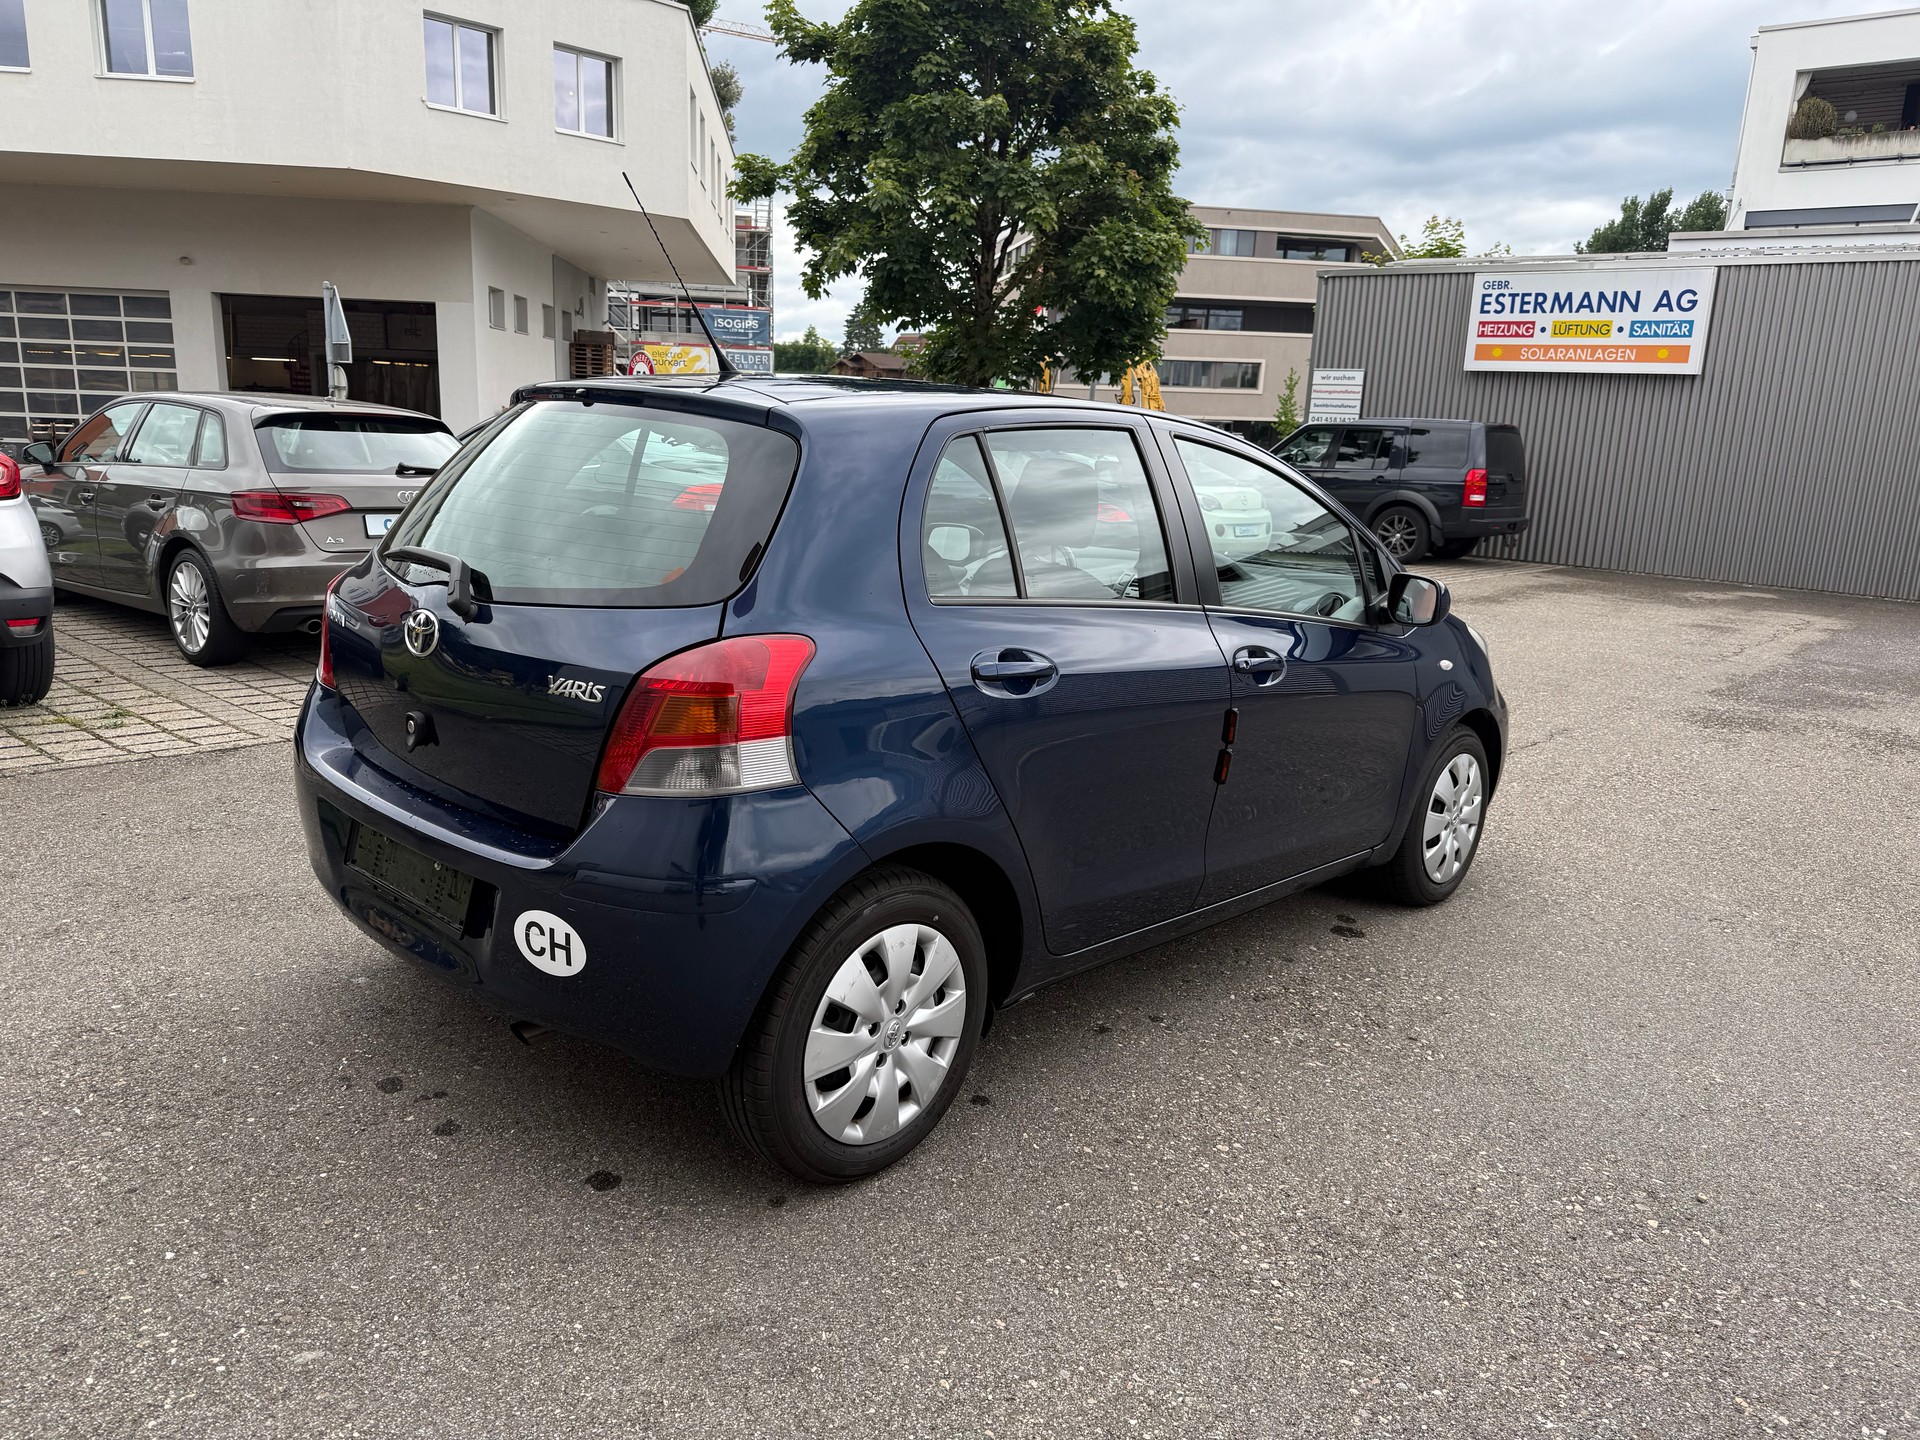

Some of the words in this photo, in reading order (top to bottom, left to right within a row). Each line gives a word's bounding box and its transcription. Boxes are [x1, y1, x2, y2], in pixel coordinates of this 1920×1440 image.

[1482, 280, 1513, 290] GEBR.
[1479, 290, 1642, 314] ESTERMANN
[1652, 289, 1699, 313] AG
[714, 318, 759, 329] ISOGIPS
[1477, 323, 1534, 336] HEIZUNG
[1552, 321, 1611, 336] LÜFTUNG
[1632, 320, 1690, 336] SANITÄR
[652, 350, 683, 359] elektro
[728, 354, 769, 365] FELDER
[1519, 347, 1637, 361] SOLARANLAGEN
[325, 536, 345, 544] A3
[547, 674, 607, 703] YARIS
[524, 920, 573, 967] CH
